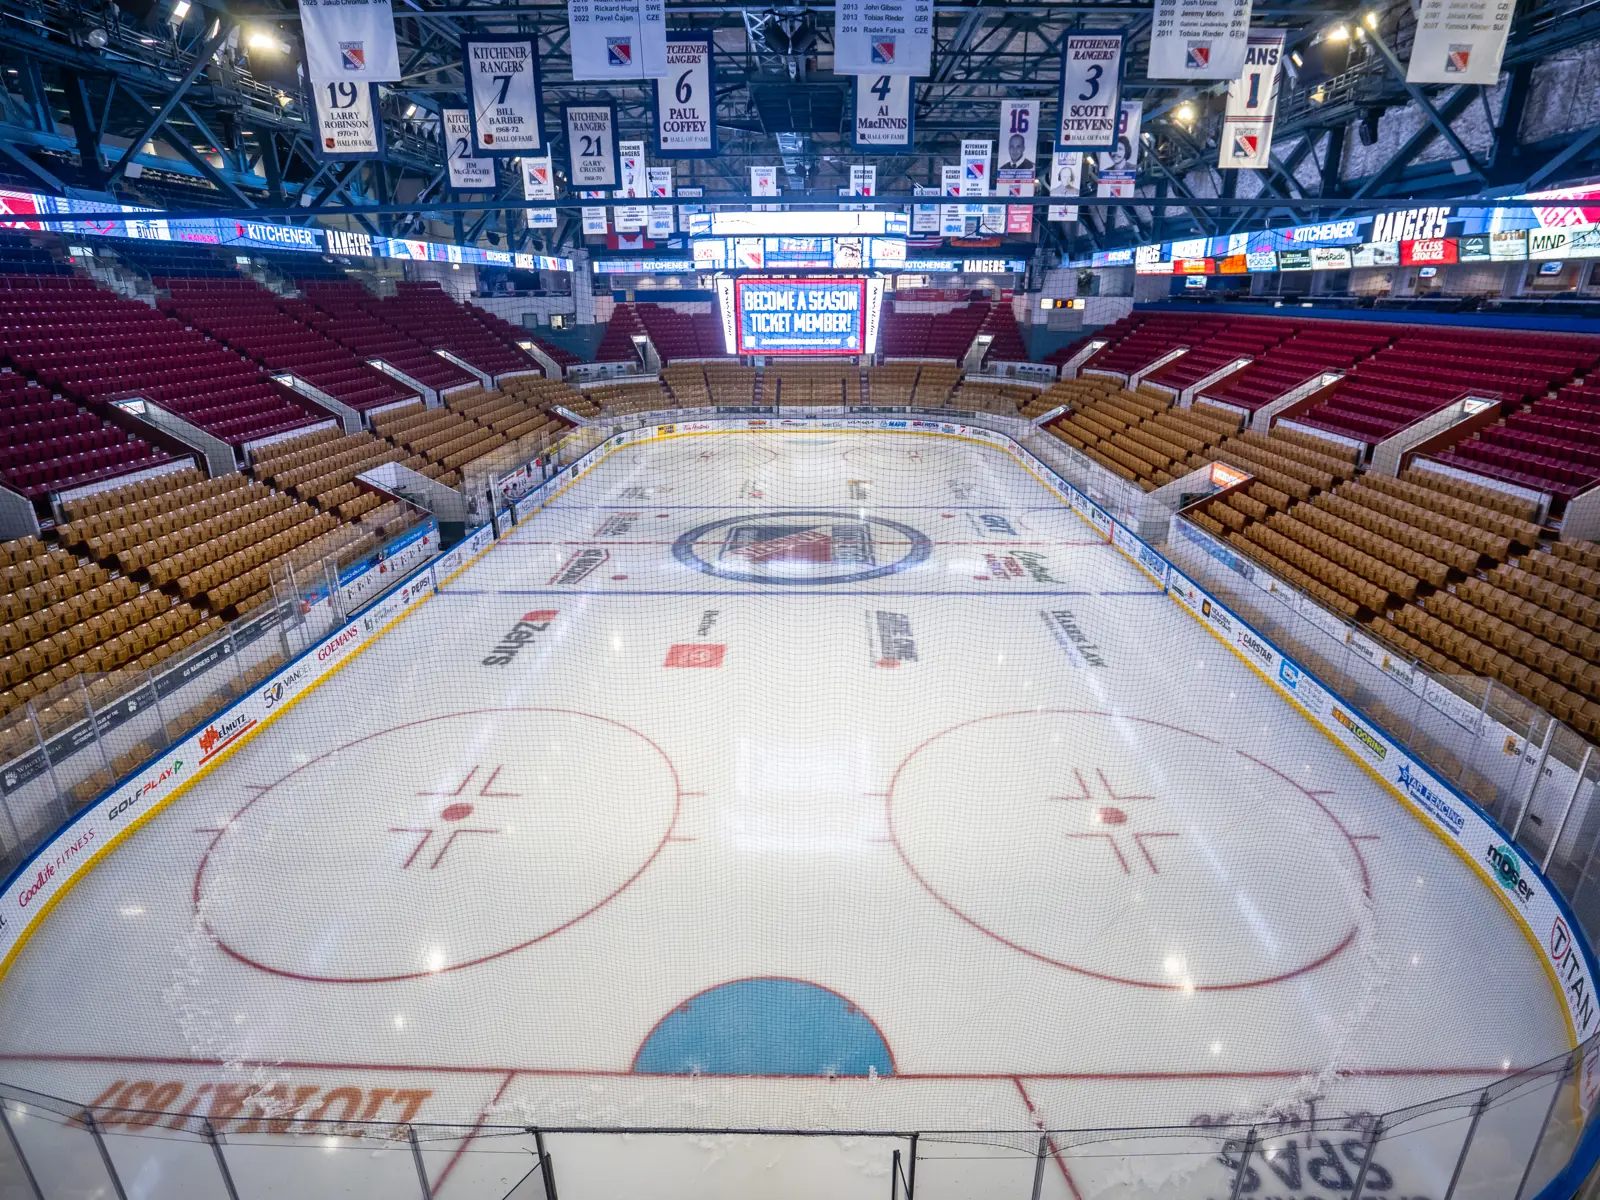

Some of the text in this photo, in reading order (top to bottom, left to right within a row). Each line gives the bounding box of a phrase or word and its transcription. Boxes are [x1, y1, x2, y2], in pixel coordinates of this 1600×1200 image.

[473, 47, 526, 58] KITCHENER
[667, 45, 708, 53] TCHENER
[1069, 40, 1119, 49] KITCHENER
[1073, 51, 1114, 60] RANGERS
[480, 61, 523, 73] RANGERS
[493, 76, 511, 104] 7
[676, 69, 692, 104] 6
[871, 76, 891, 100] 4
[1079, 65, 1103, 100] 3
[1247, 74, 1261, 108] 1
[327, 82, 357, 108] 19
[330, 112, 359, 120] LARRY
[447, 115, 468, 123] KITCH
[570, 112, 609, 121] KITCHENER
[670, 108, 698, 119] PAUL
[1071, 106, 1108, 116] SCOTT
[574, 122, 606, 131] RANGERS
[664, 121, 706, 132] COFFEY
[858, 118, 907, 129] MacINNIS
[1010, 109, 1029, 133] 16
[1064, 119, 1112, 130] STEVENS
[580, 136, 602, 156] 21
[1293, 221, 1355, 243] KITCHENER
[1372, 206, 1450, 242] RANGERS
[248, 224, 372, 256] KITCHENER RANGERS
[1412, 241, 1444, 253] ACCESS
[1532, 234, 1565, 249] MNP
[643, 262, 689, 270] KITCHENER
[905, 260, 1005, 273] KITCHENER RANGERS
[745, 292, 857, 311] BECOME A SEASON
[750, 313, 851, 332] TICKET MEMBER!
[411, 575, 430, 596] PEPSI
[317, 625, 359, 661] GOEMANS
[482, 621, 550, 667] Zehrs
[1243, 633, 1273, 663] CARSTAR
[189, 656, 211, 672] RANGERS
[1349, 724, 1387, 759] FLOORING
[1403, 770, 1465, 829] STAR FENCING
[19, 828, 95, 907] GoodLife FITNESS
[1487, 844, 1535, 901] moser
[1553, 924, 1593, 1031] TITAN
